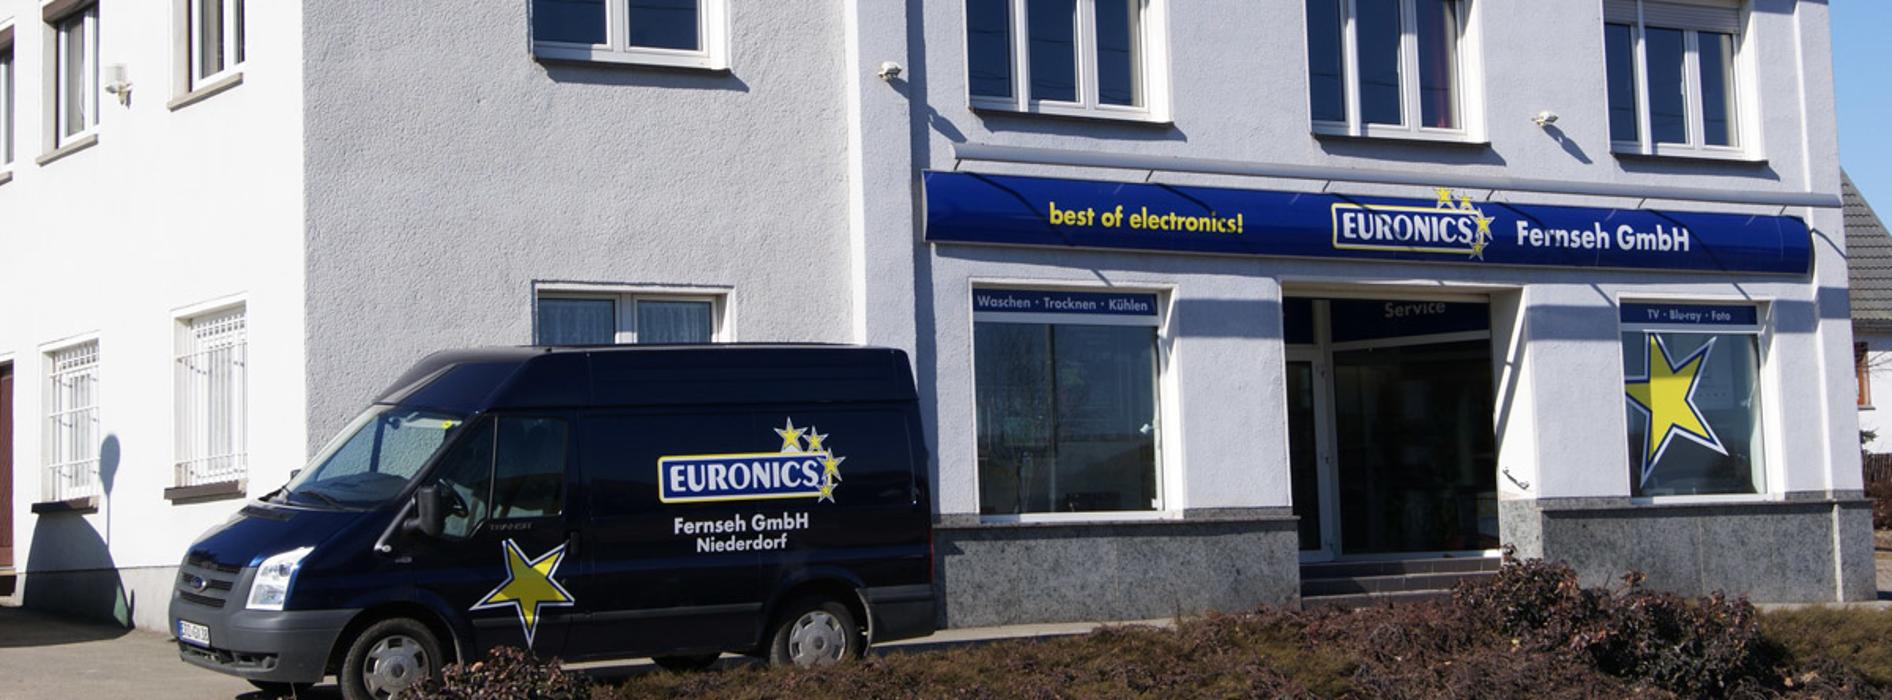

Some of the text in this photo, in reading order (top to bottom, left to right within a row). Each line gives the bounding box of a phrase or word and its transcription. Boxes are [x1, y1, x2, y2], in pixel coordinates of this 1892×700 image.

[1049, 201, 1244, 234] best of electronics!
[1342, 211, 1472, 245] EURONICS
[1516, 220, 1690, 253] Fernseh GmbH
[977, 295, 1149, 312] Waschen Trocknen Kühlen
[1384, 302, 1447, 318] Service
[1648, 308, 1660, 320] TV
[1711, 310, 1731, 321] Foto
[670, 460, 820, 492] EURONICS
[674, 511, 809, 535] Fernseh GmbH
[696, 532, 788, 553] Niederdorf
